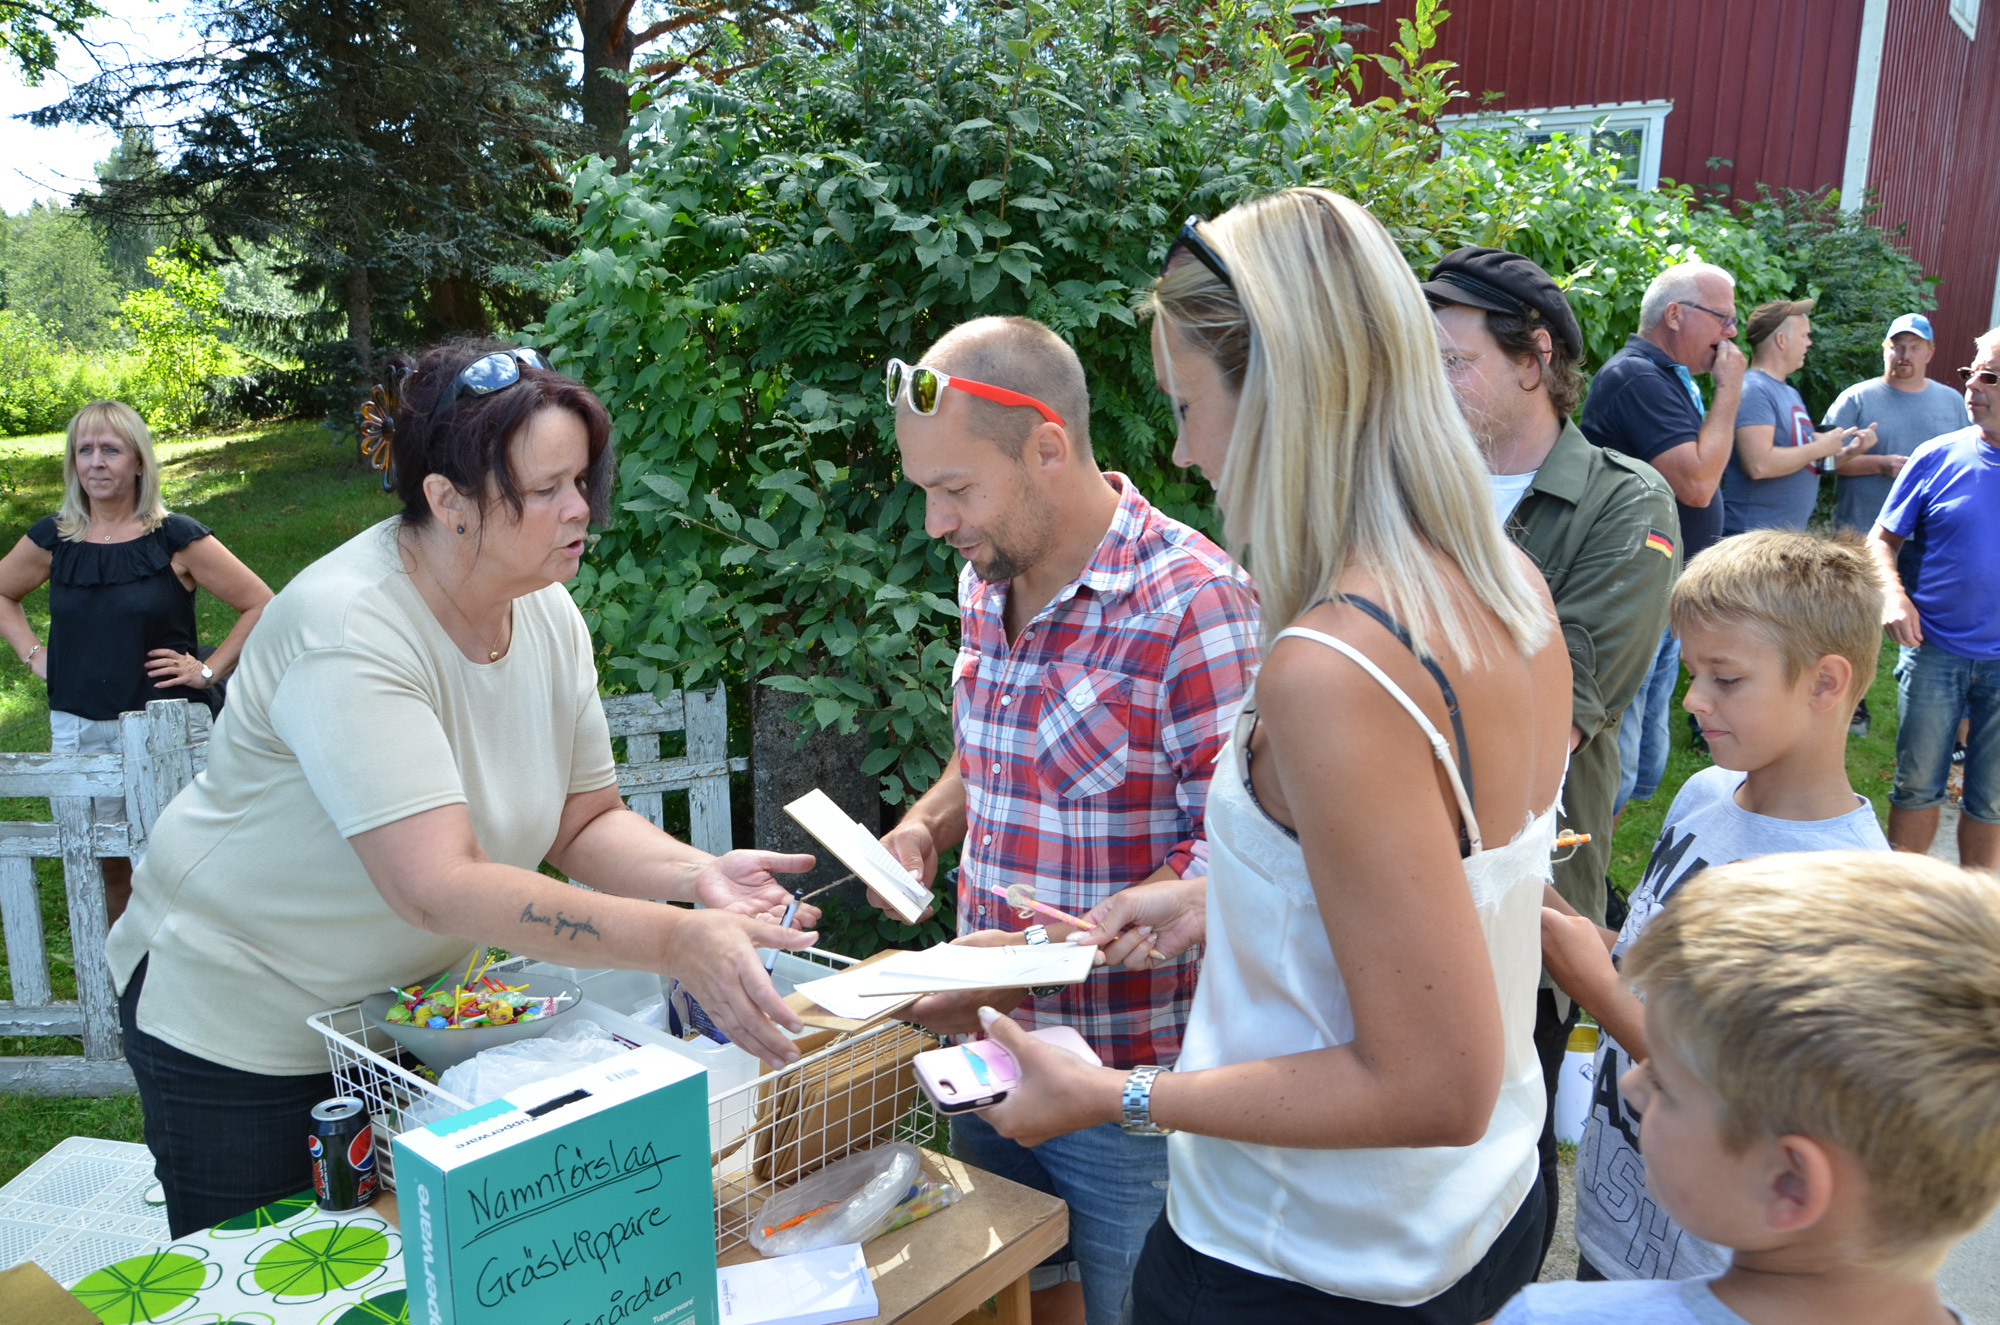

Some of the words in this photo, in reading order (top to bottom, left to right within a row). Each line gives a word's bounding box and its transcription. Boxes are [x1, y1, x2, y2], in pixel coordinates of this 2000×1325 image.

[454, 1116, 540, 1151] Tupperware
[467, 1139, 663, 1226] Namnförslag
[476, 1206, 672, 1308] Gräsklippare
[652, 1298, 694, 1324] Tupperware
